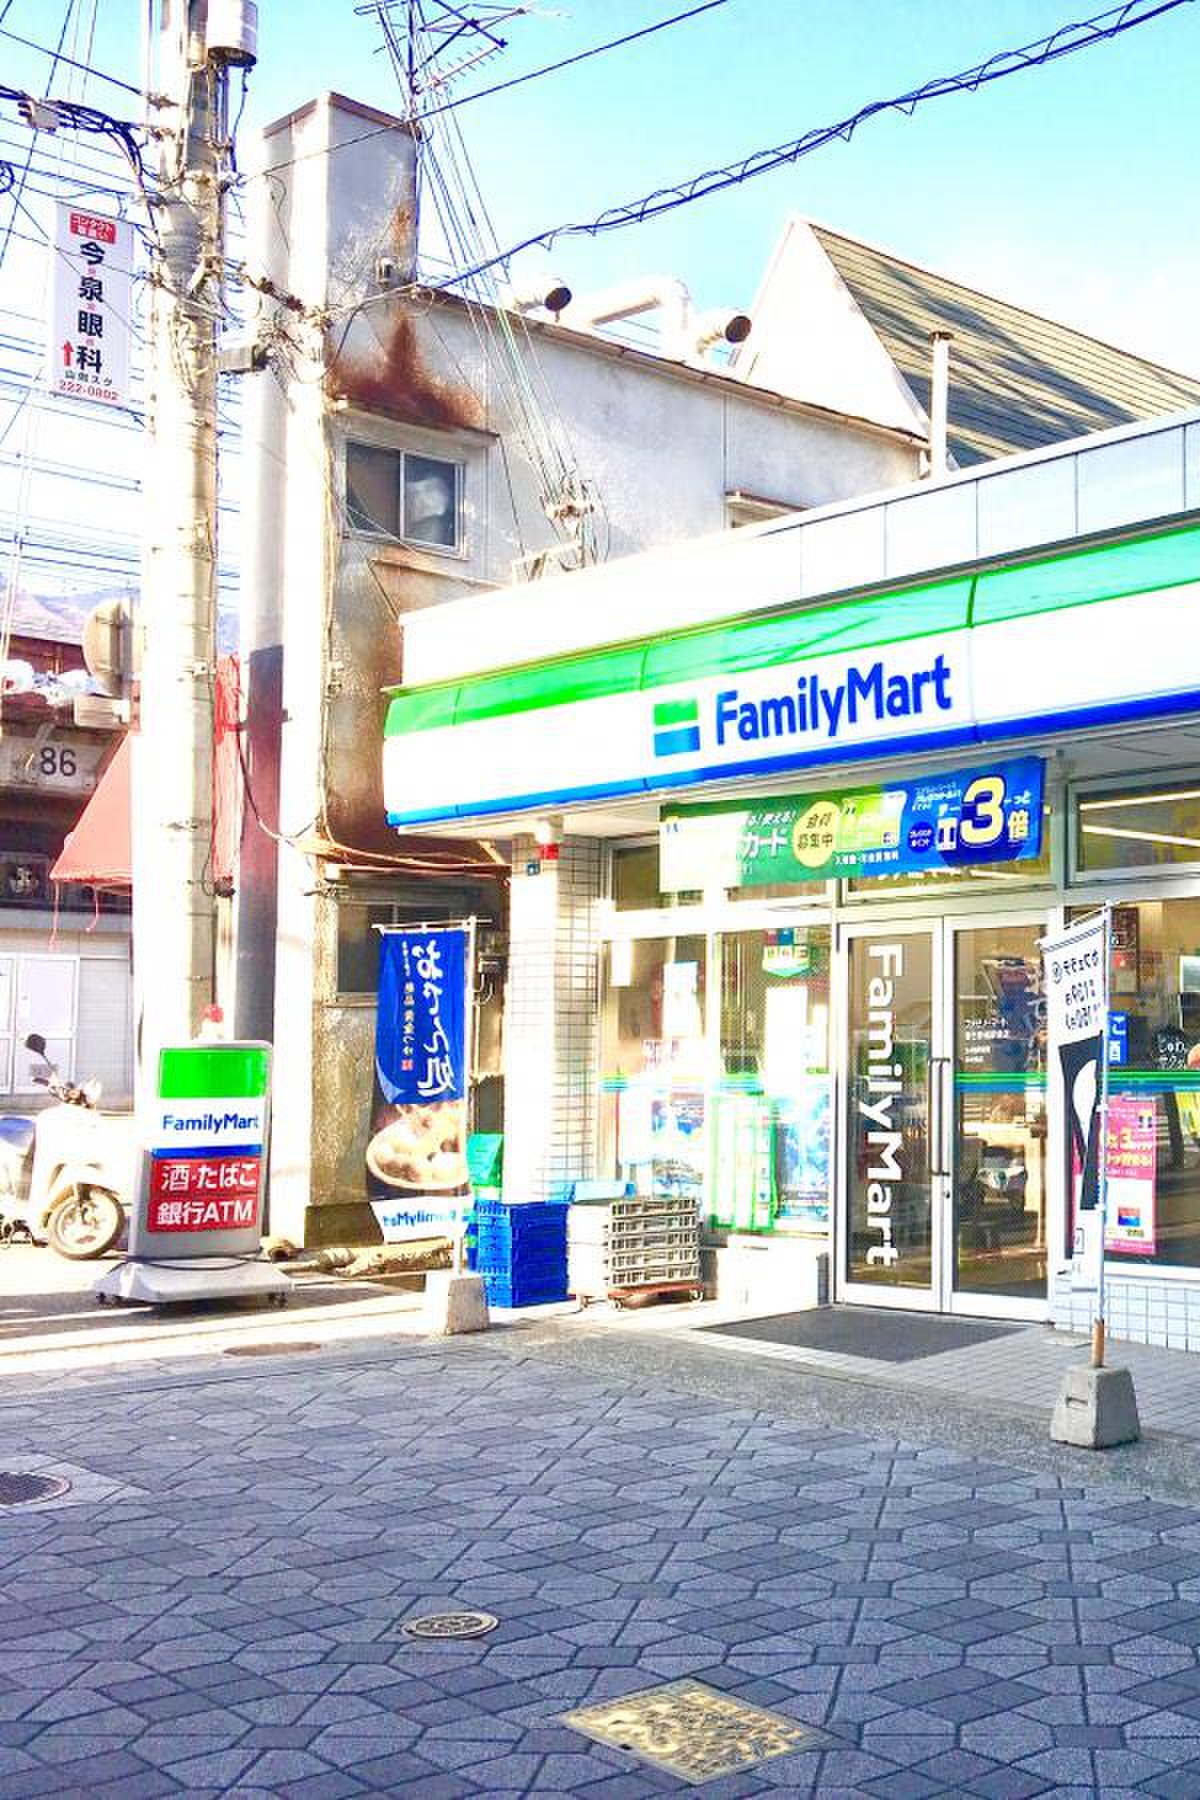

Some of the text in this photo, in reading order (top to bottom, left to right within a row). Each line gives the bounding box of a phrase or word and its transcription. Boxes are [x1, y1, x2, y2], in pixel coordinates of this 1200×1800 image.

[76, 241, 105, 374] 今泉眼科
[717, 654, 952, 745] FamilyMart
[40, 746, 77, 776] 86
[162, 1113, 259, 1134] FamilyMart
[859, 943, 903, 1267] FamilyMart
[157, 1199, 254, 1226] 銀行ATM
